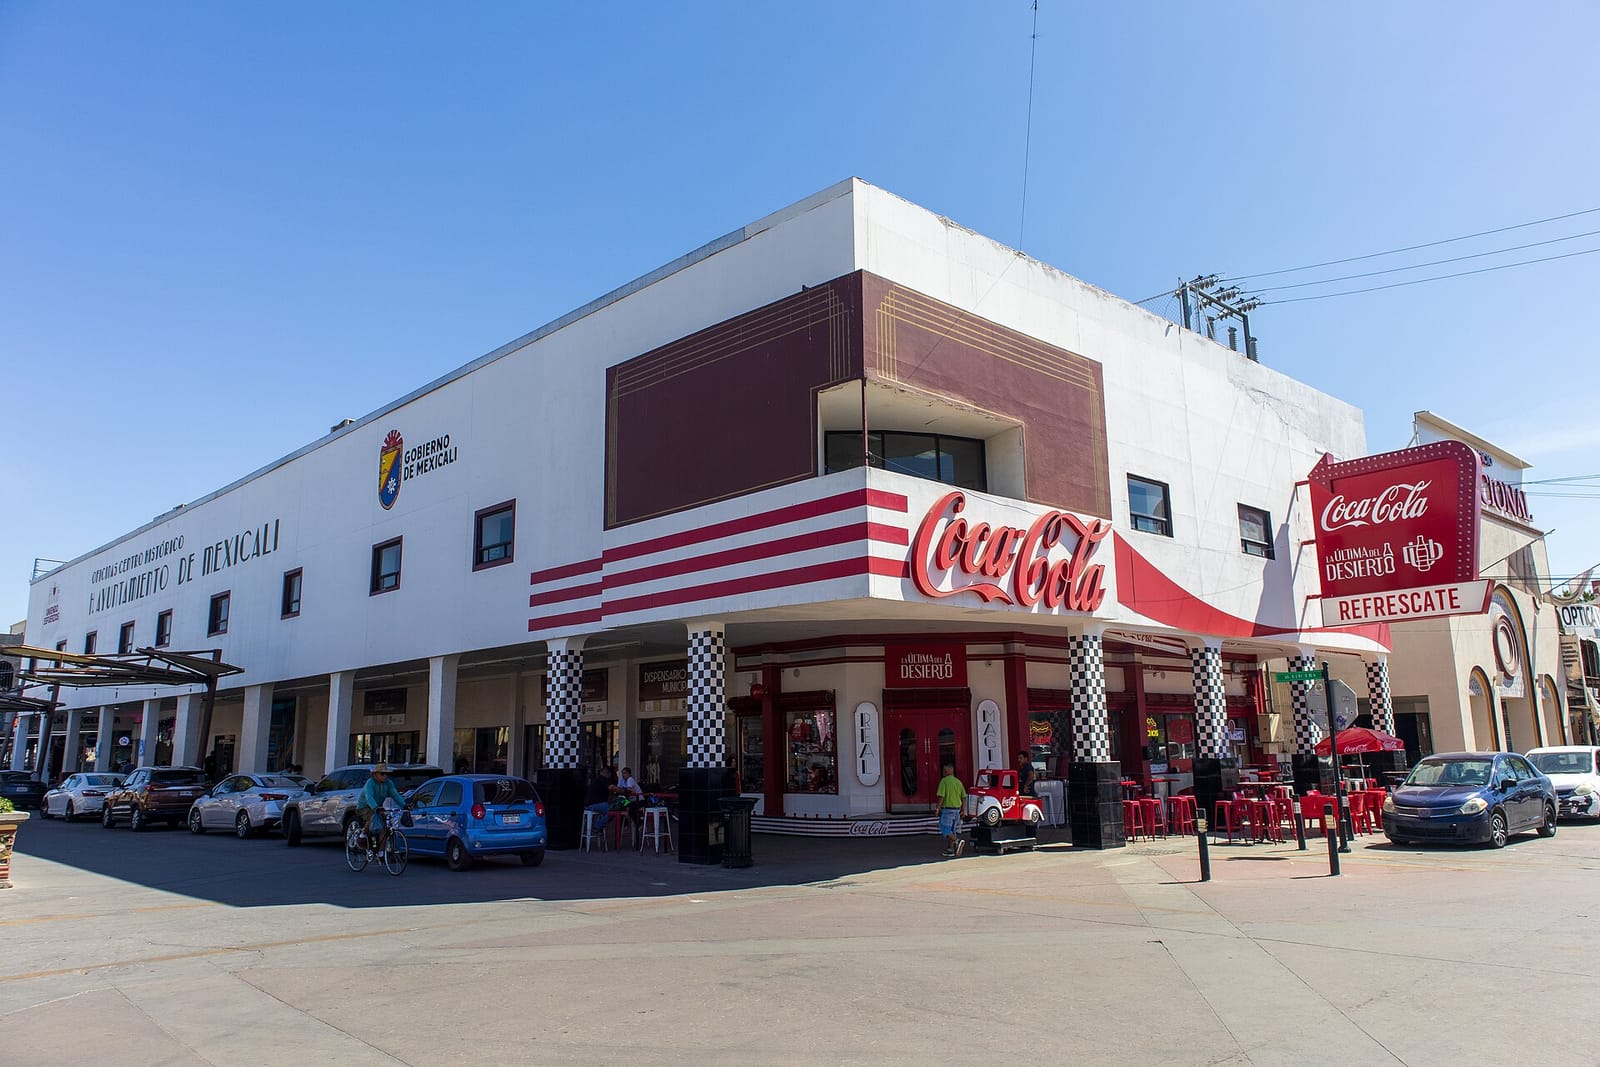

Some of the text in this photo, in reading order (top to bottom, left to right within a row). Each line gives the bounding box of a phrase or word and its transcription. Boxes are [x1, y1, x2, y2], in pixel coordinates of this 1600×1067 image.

[404, 434, 450, 464] GOBIERNO
[404, 446, 458, 481] DE MEXICALI
[1320, 480, 1432, 532] Coca-Cola
[96, 564, 170, 611] AYUNTAMIENTO
[178, 552, 195, 586] DE
[202, 518, 280, 577] MEXICALI
[911, 491, 1112, 612] Coca-Cola
[1325, 547, 1381, 564] LA ÚLTIMA DEL
[91, 562, 118, 585] OFICINAS
[118, 552, 143, 575] CENTRO
[1338, 587, 1461, 621] REFRESCATE
[644, 668, 687, 683] DISPENSARIO
[662, 681, 687, 693] MUNICIP
[860, 712, 875, 774] REAL
[849, 821, 888, 836] Coca-Cola
